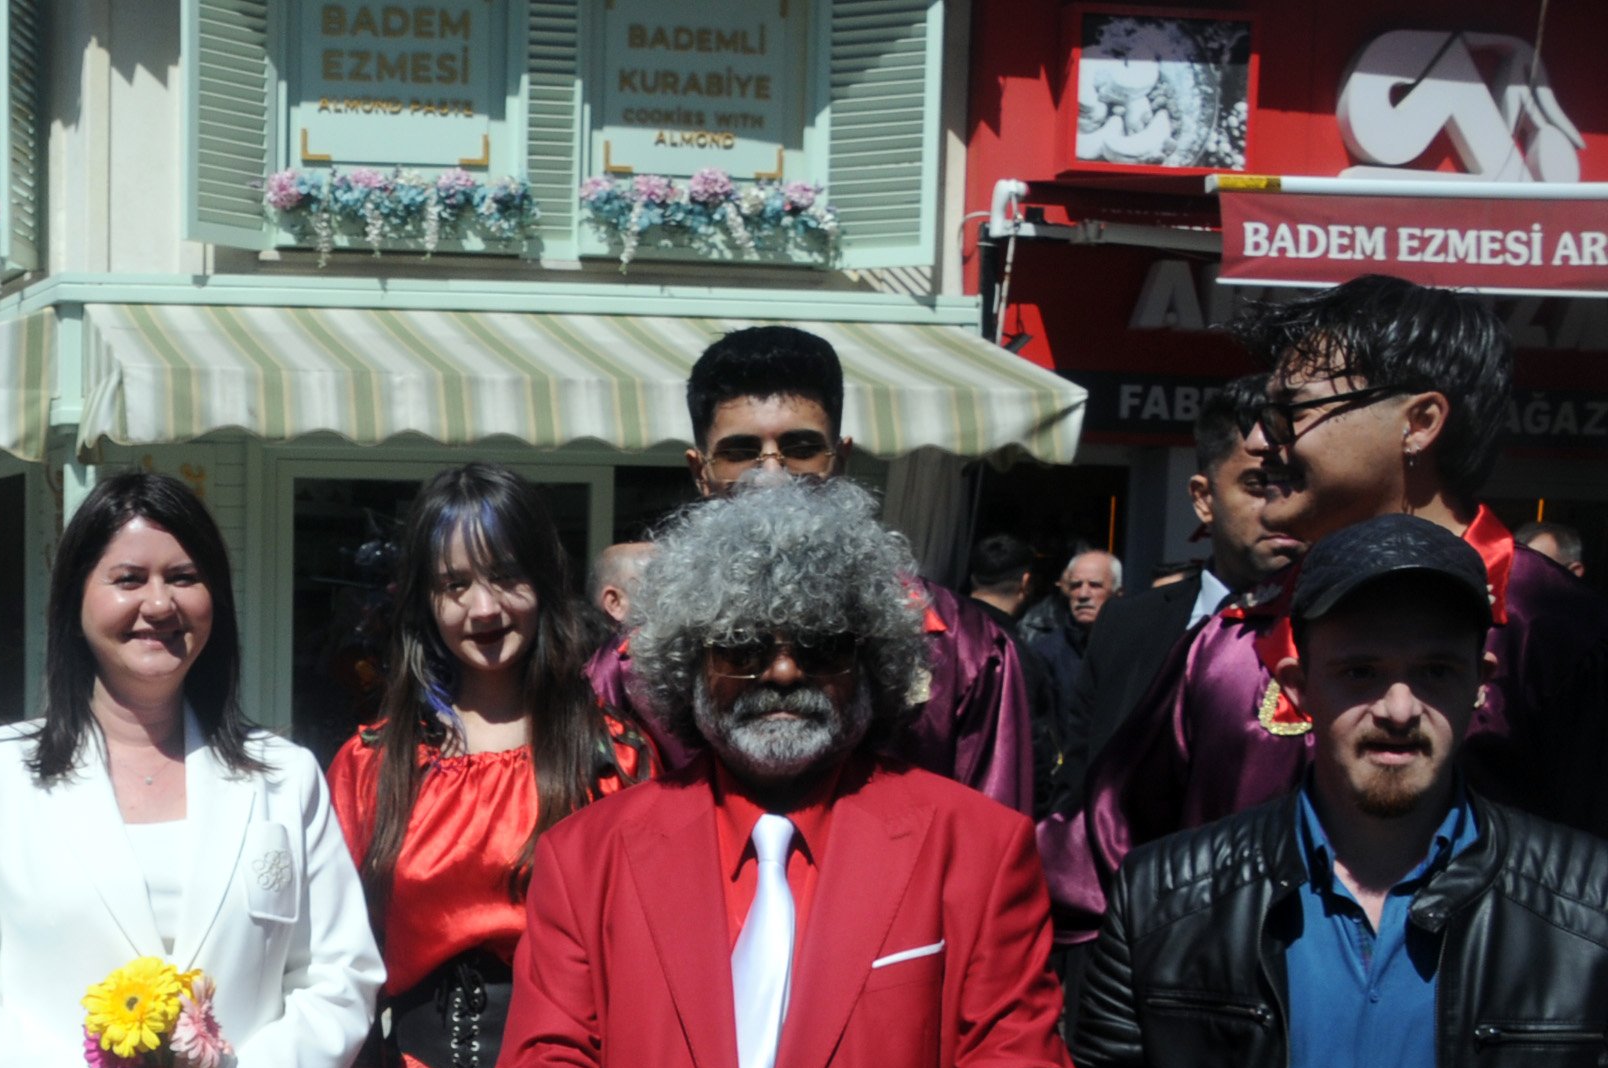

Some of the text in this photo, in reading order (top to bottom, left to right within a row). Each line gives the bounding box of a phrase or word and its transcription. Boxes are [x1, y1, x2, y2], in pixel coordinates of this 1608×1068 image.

[321, 5, 472, 40] BADEM
[628, 23, 767, 56] BADEMLİ
[322, 46, 470, 85] EZMESİ
[618, 66, 772, 101] KURABİYE
[318, 97, 404, 116] ALMOND
[654, 129, 735, 150] ALMOND
[1242, 222, 1608, 266] BADEM EZMESİ AR
